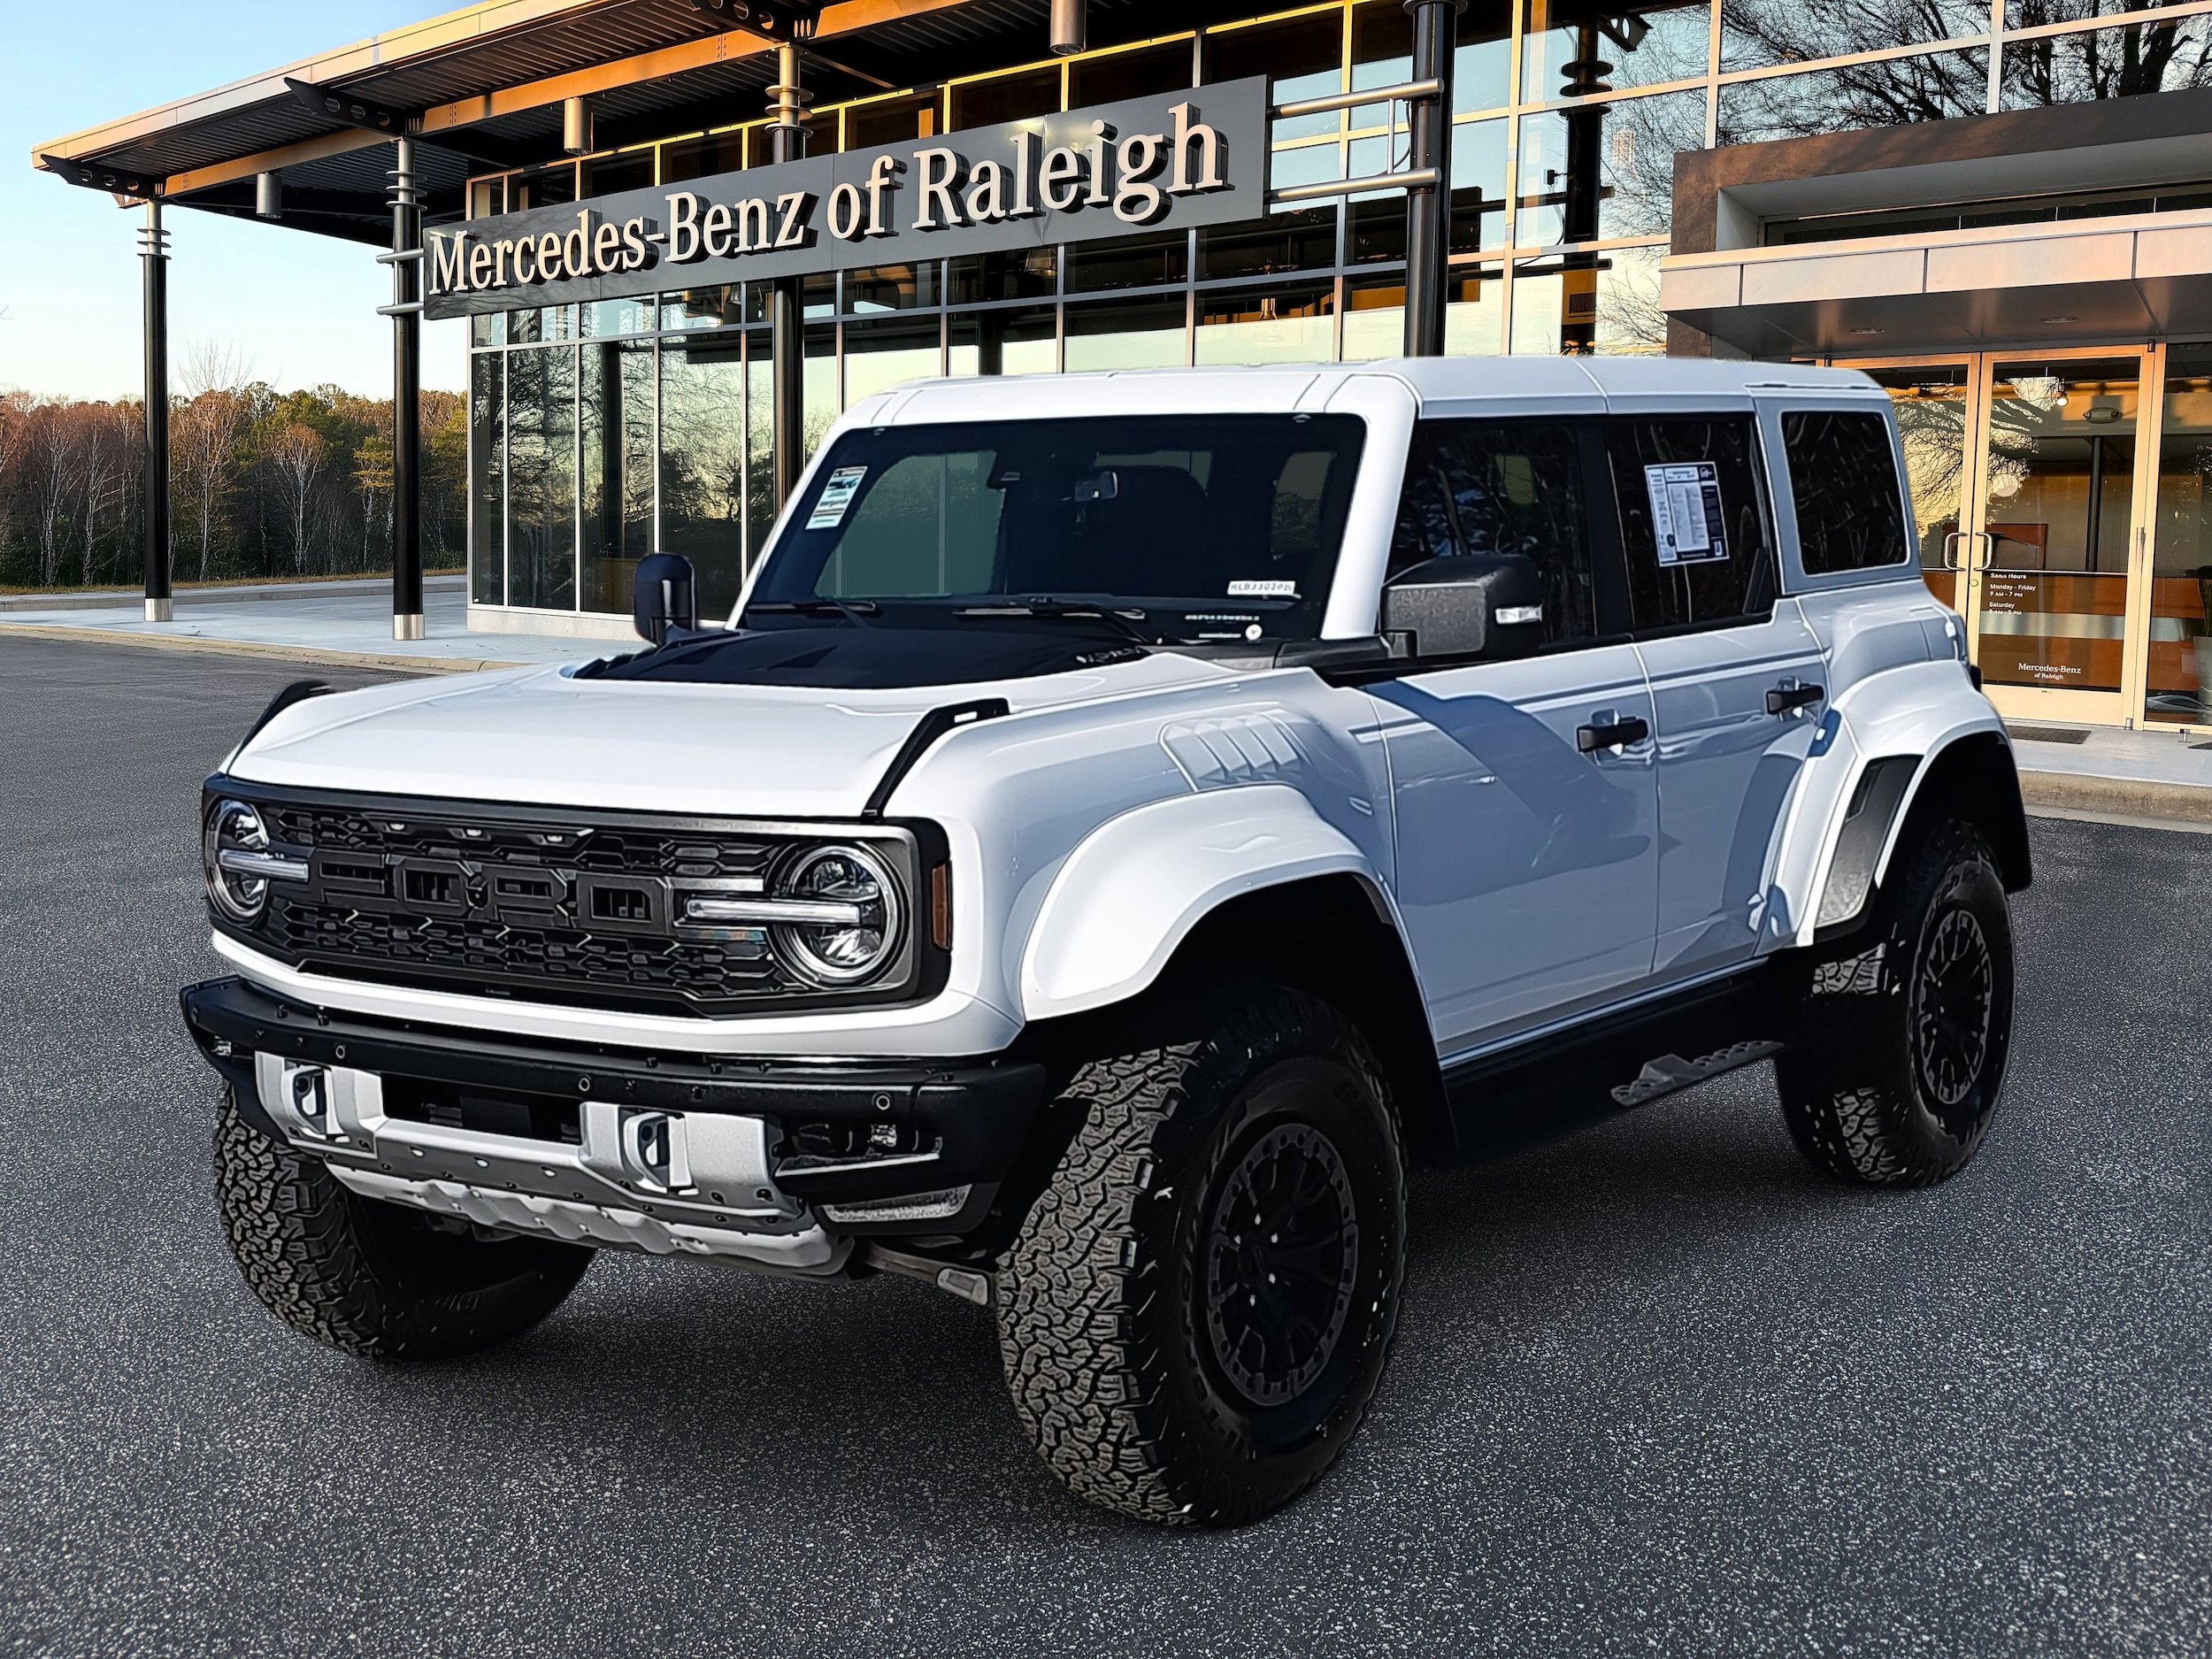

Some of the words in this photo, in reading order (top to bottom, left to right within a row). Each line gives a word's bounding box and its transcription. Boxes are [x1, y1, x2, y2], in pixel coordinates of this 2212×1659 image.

[429, 190, 807, 296] Mercedes-Benz
[826, 155, 895, 240] of
[911, 101, 1225, 224] Raleigh
[2018, 663, 2081, 673] Mercedes-Benz
[310, 849, 670, 934] FORD
